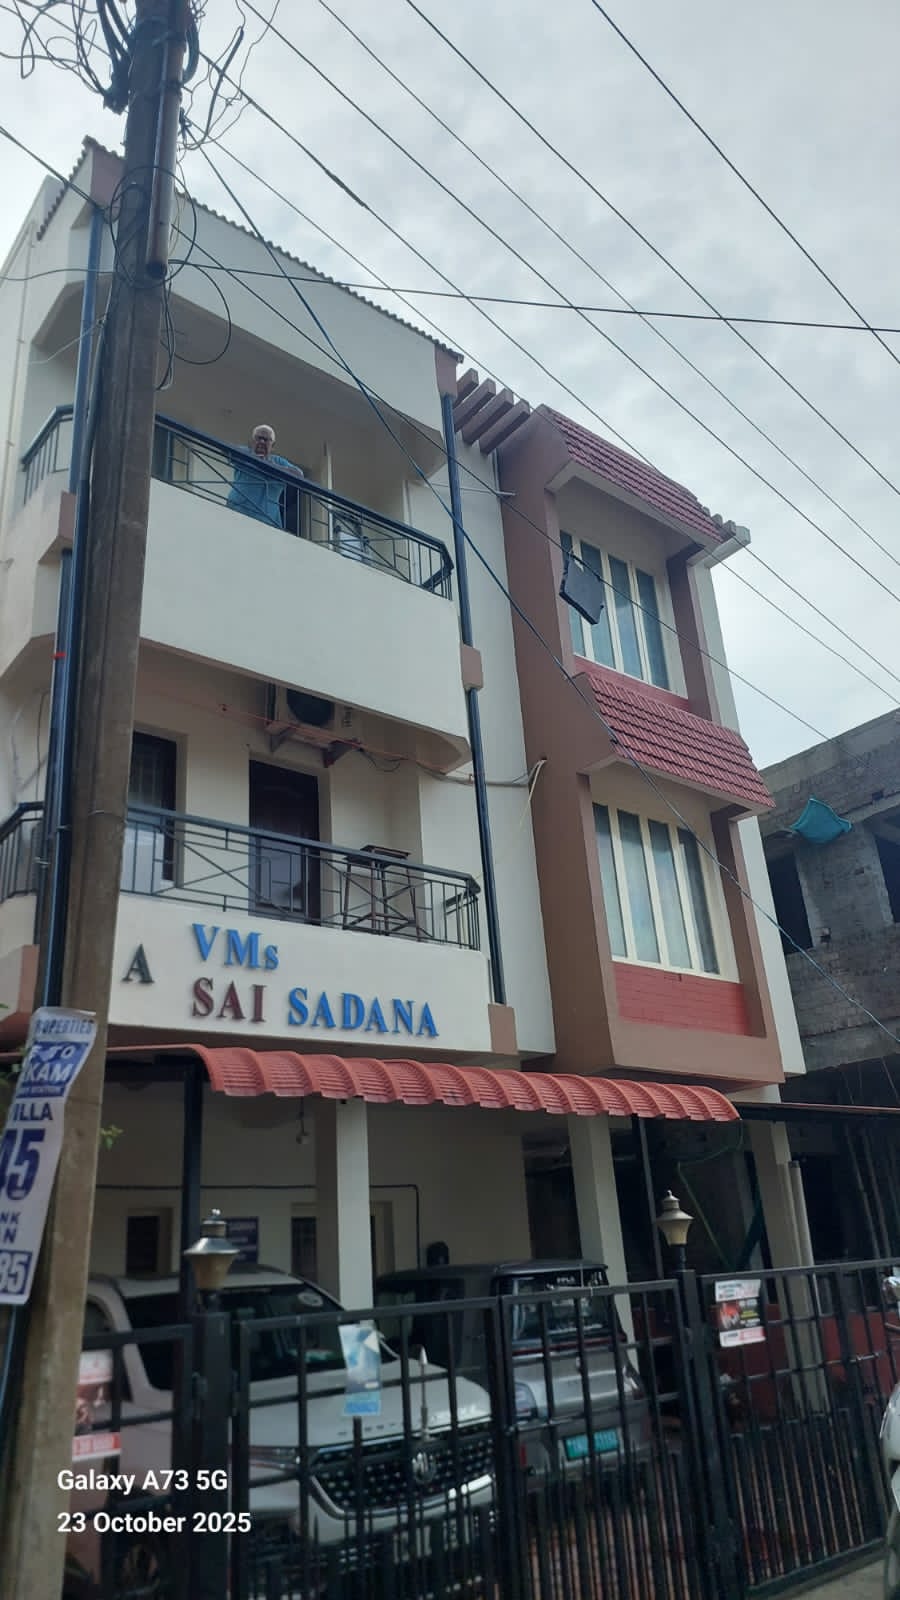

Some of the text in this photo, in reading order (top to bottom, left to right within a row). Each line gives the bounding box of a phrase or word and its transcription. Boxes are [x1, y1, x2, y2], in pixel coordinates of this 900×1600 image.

[192, 923, 280, 971] VMs
[192, 977, 439, 1037] SAI SADANA
